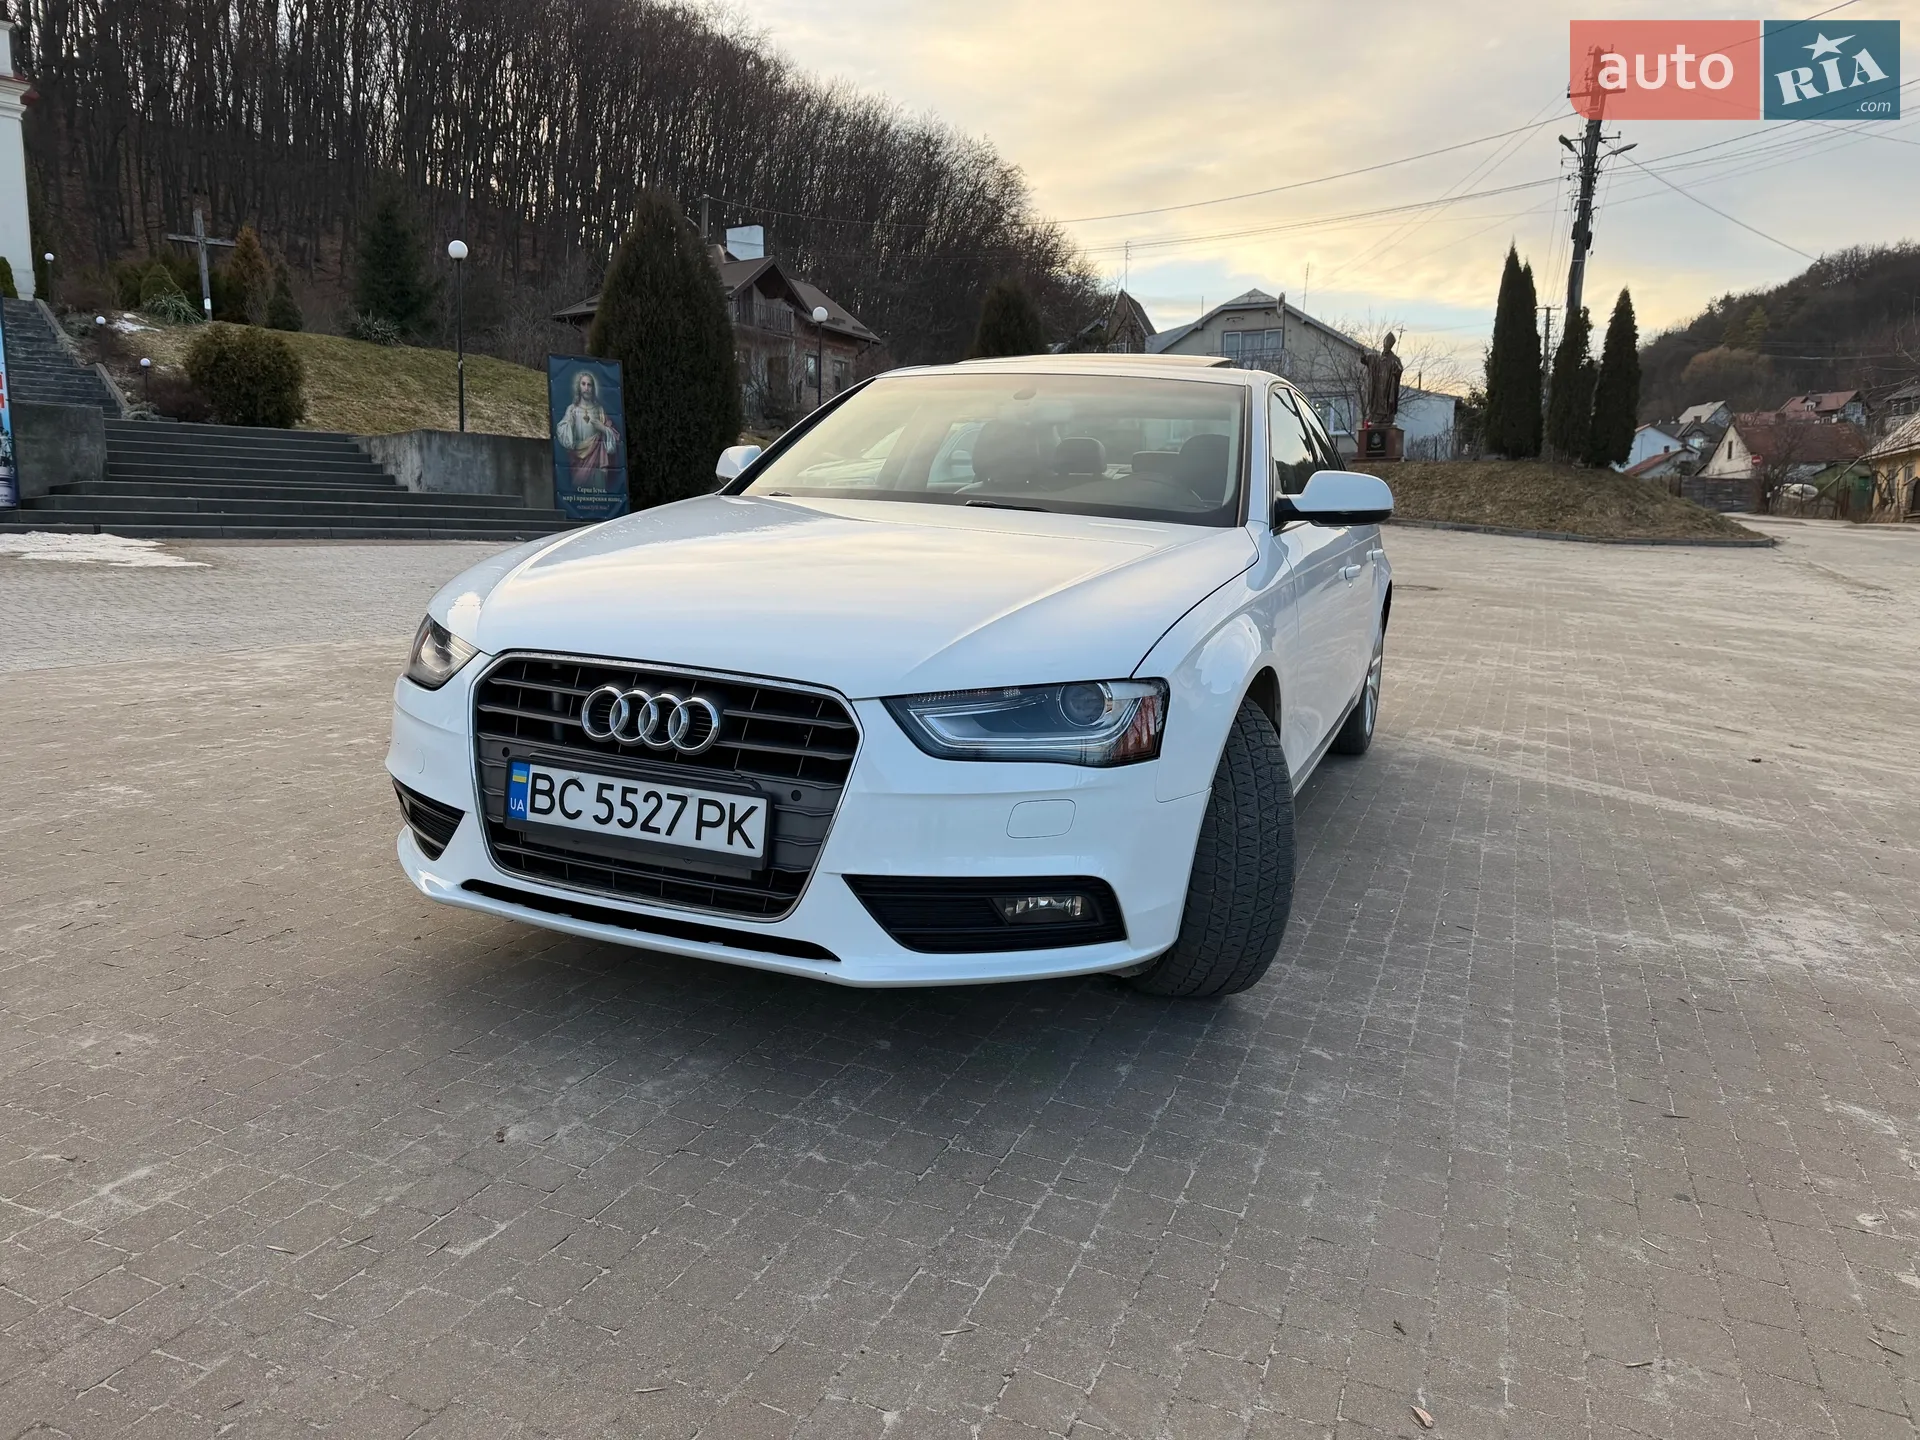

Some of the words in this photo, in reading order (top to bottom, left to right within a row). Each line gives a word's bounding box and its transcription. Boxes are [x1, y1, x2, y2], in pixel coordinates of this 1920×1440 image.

[509, 796, 525, 813] UA
[529, 772, 585, 820] BC
[592, 782, 688, 837] 5527
[695, 797, 759, 849] PK
